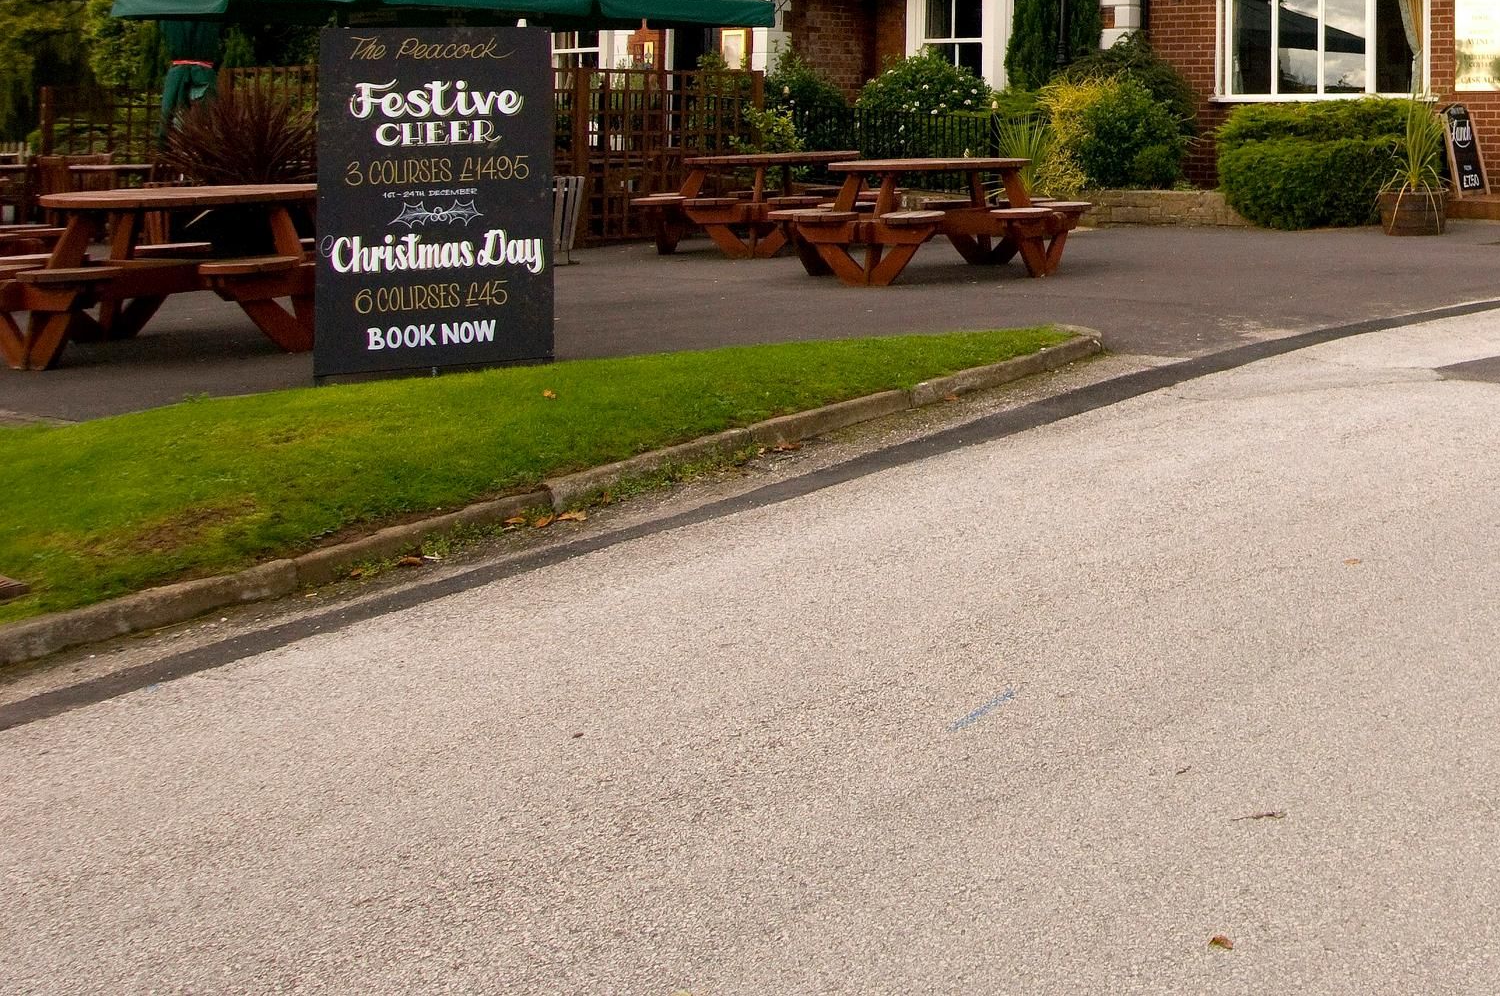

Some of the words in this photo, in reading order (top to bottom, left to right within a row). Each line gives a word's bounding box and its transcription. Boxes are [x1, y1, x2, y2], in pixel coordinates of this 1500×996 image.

[350, 35, 386, 60] The
[396, 36, 518, 60] Peacock
[350, 79, 525, 119] Festive
[375, 119, 503, 147] CHEER
[345, 161, 363, 186] 3
[369, 158, 452, 184] COURSES
[459, 155, 530, 181] £14.95
[428, 188, 478, 197] DECEMBER
[321, 234, 476, 273] Christmas
[477, 229, 545, 275] Day
[355, 288, 373, 314] 6
[377, 285, 460, 311] COURSES
[465, 280, 509, 307] £45
[367, 323, 437, 350] BOOK
[441, 320, 497, 346] NOW
